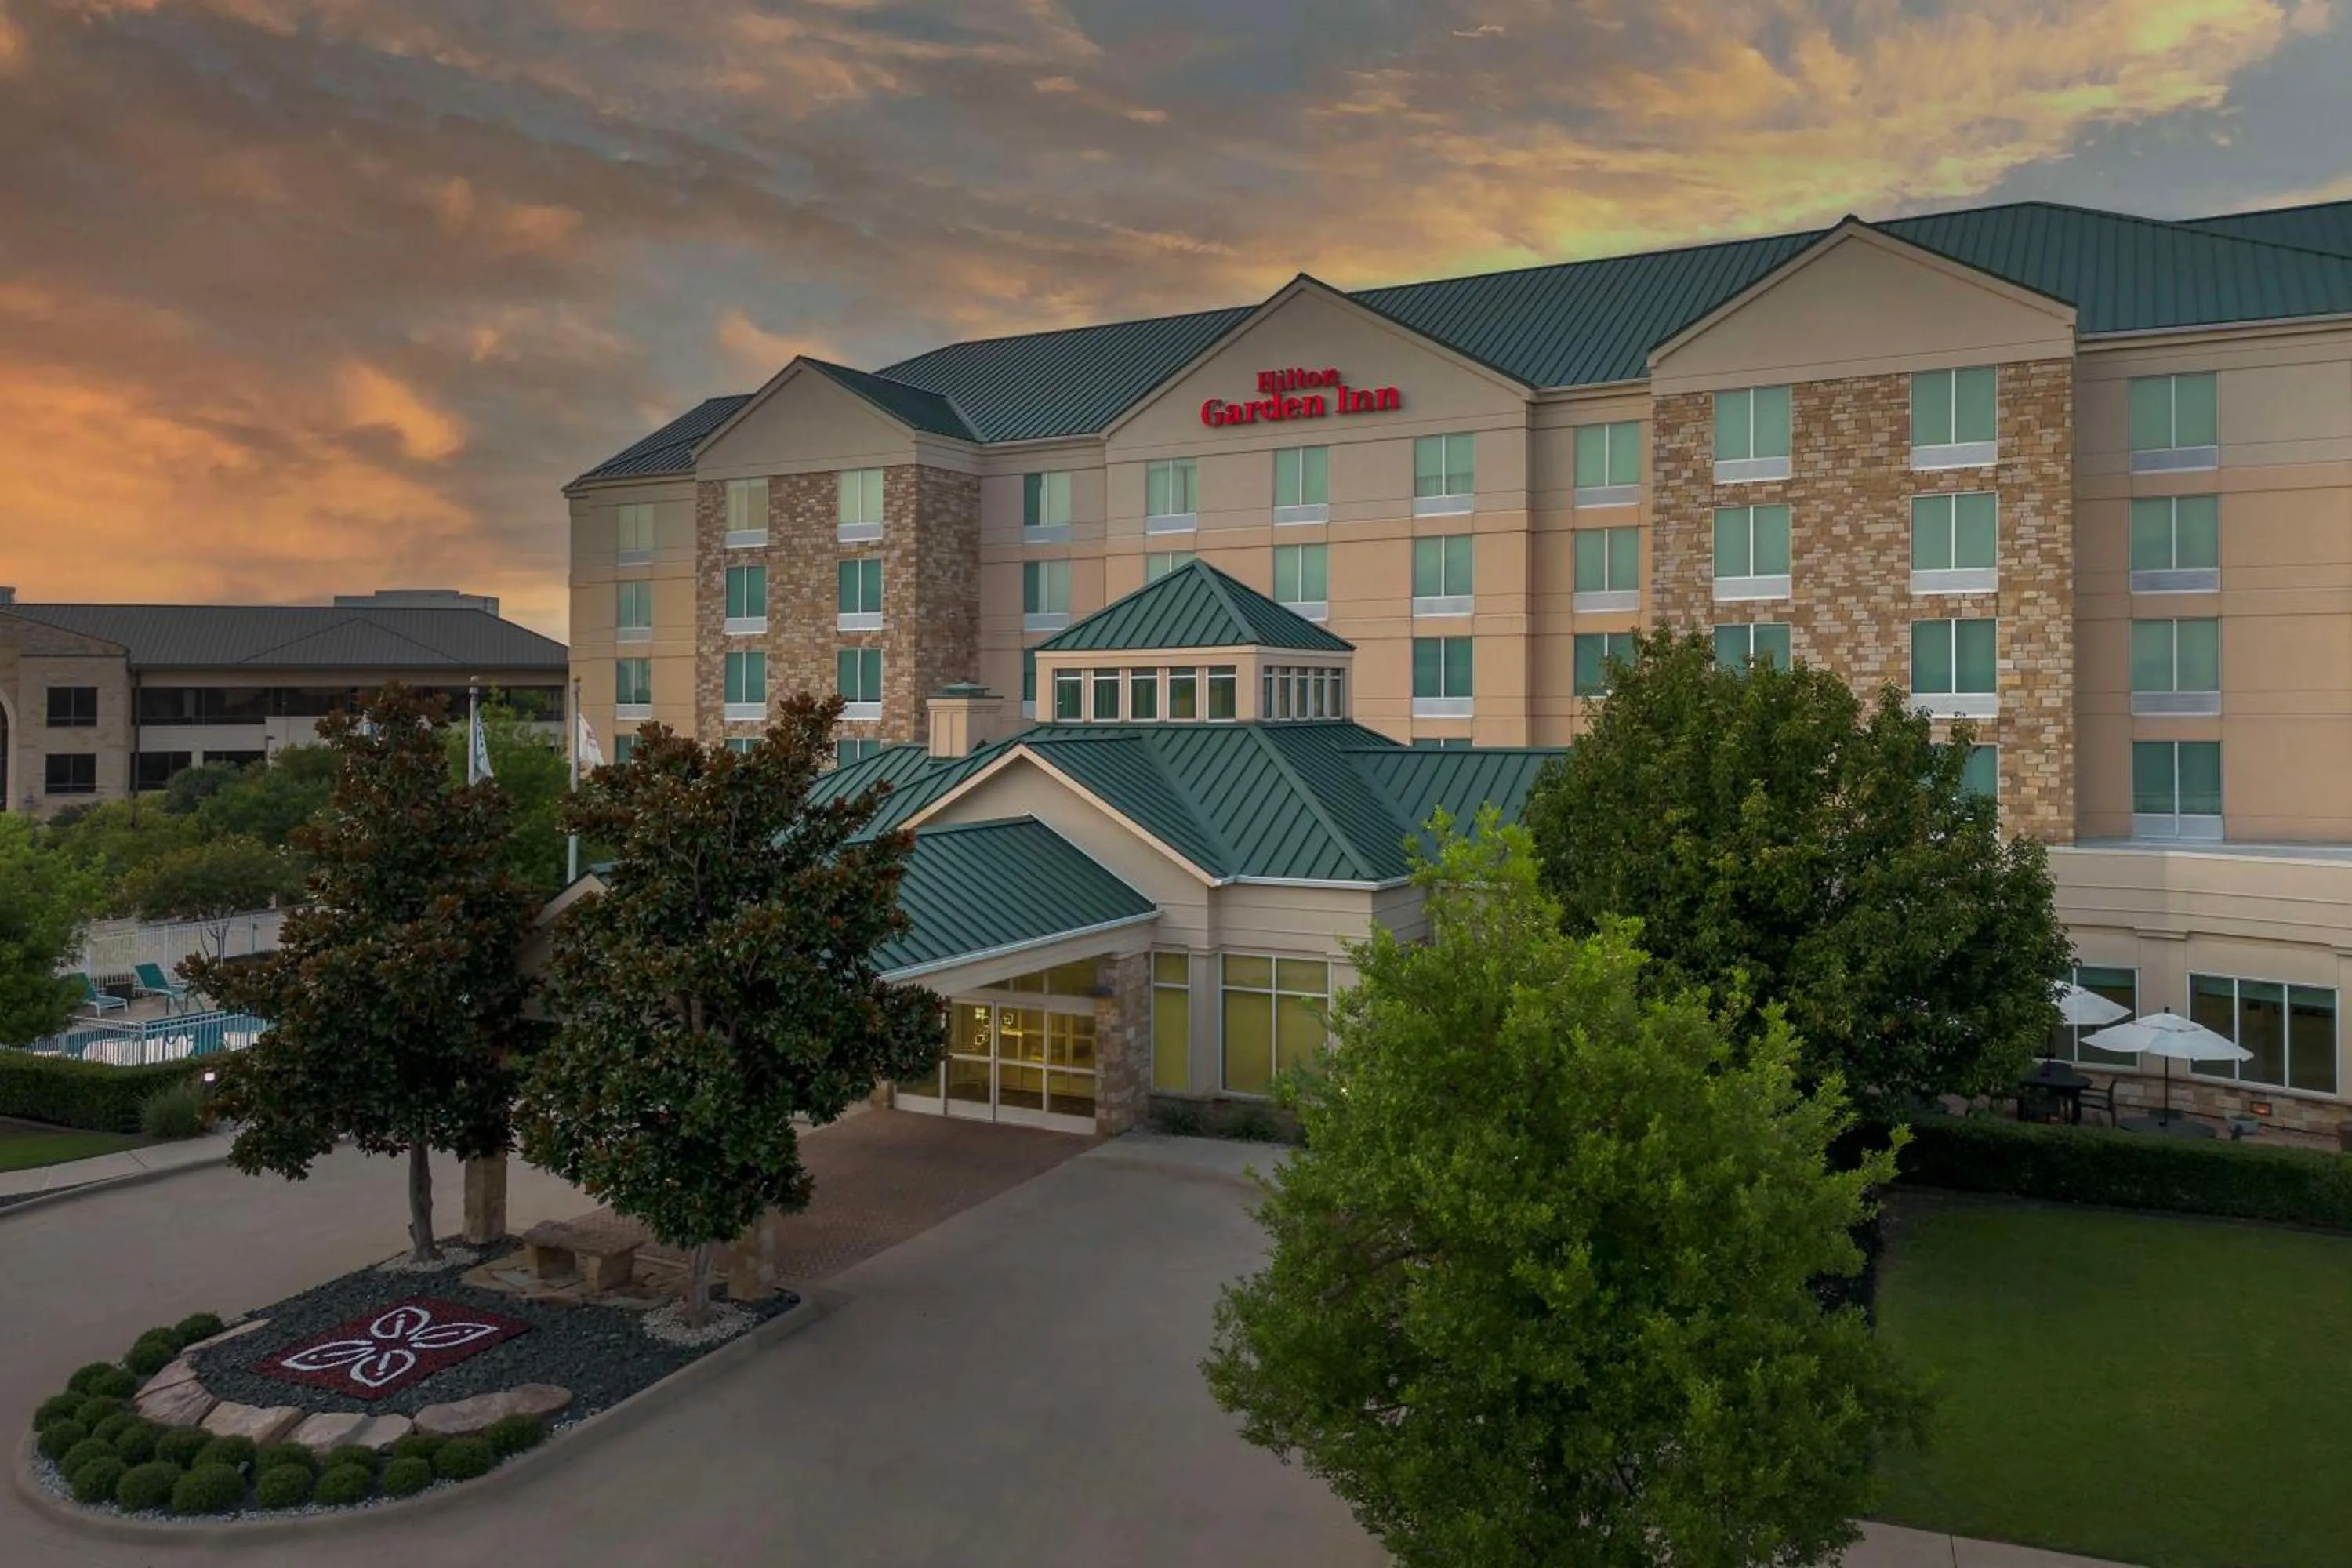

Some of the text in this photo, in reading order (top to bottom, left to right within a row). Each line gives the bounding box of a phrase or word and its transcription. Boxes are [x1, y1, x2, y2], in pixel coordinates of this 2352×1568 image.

[1257, 368, 1340, 393] Hilton
[1200, 384, 1400, 427] Garden Inn
